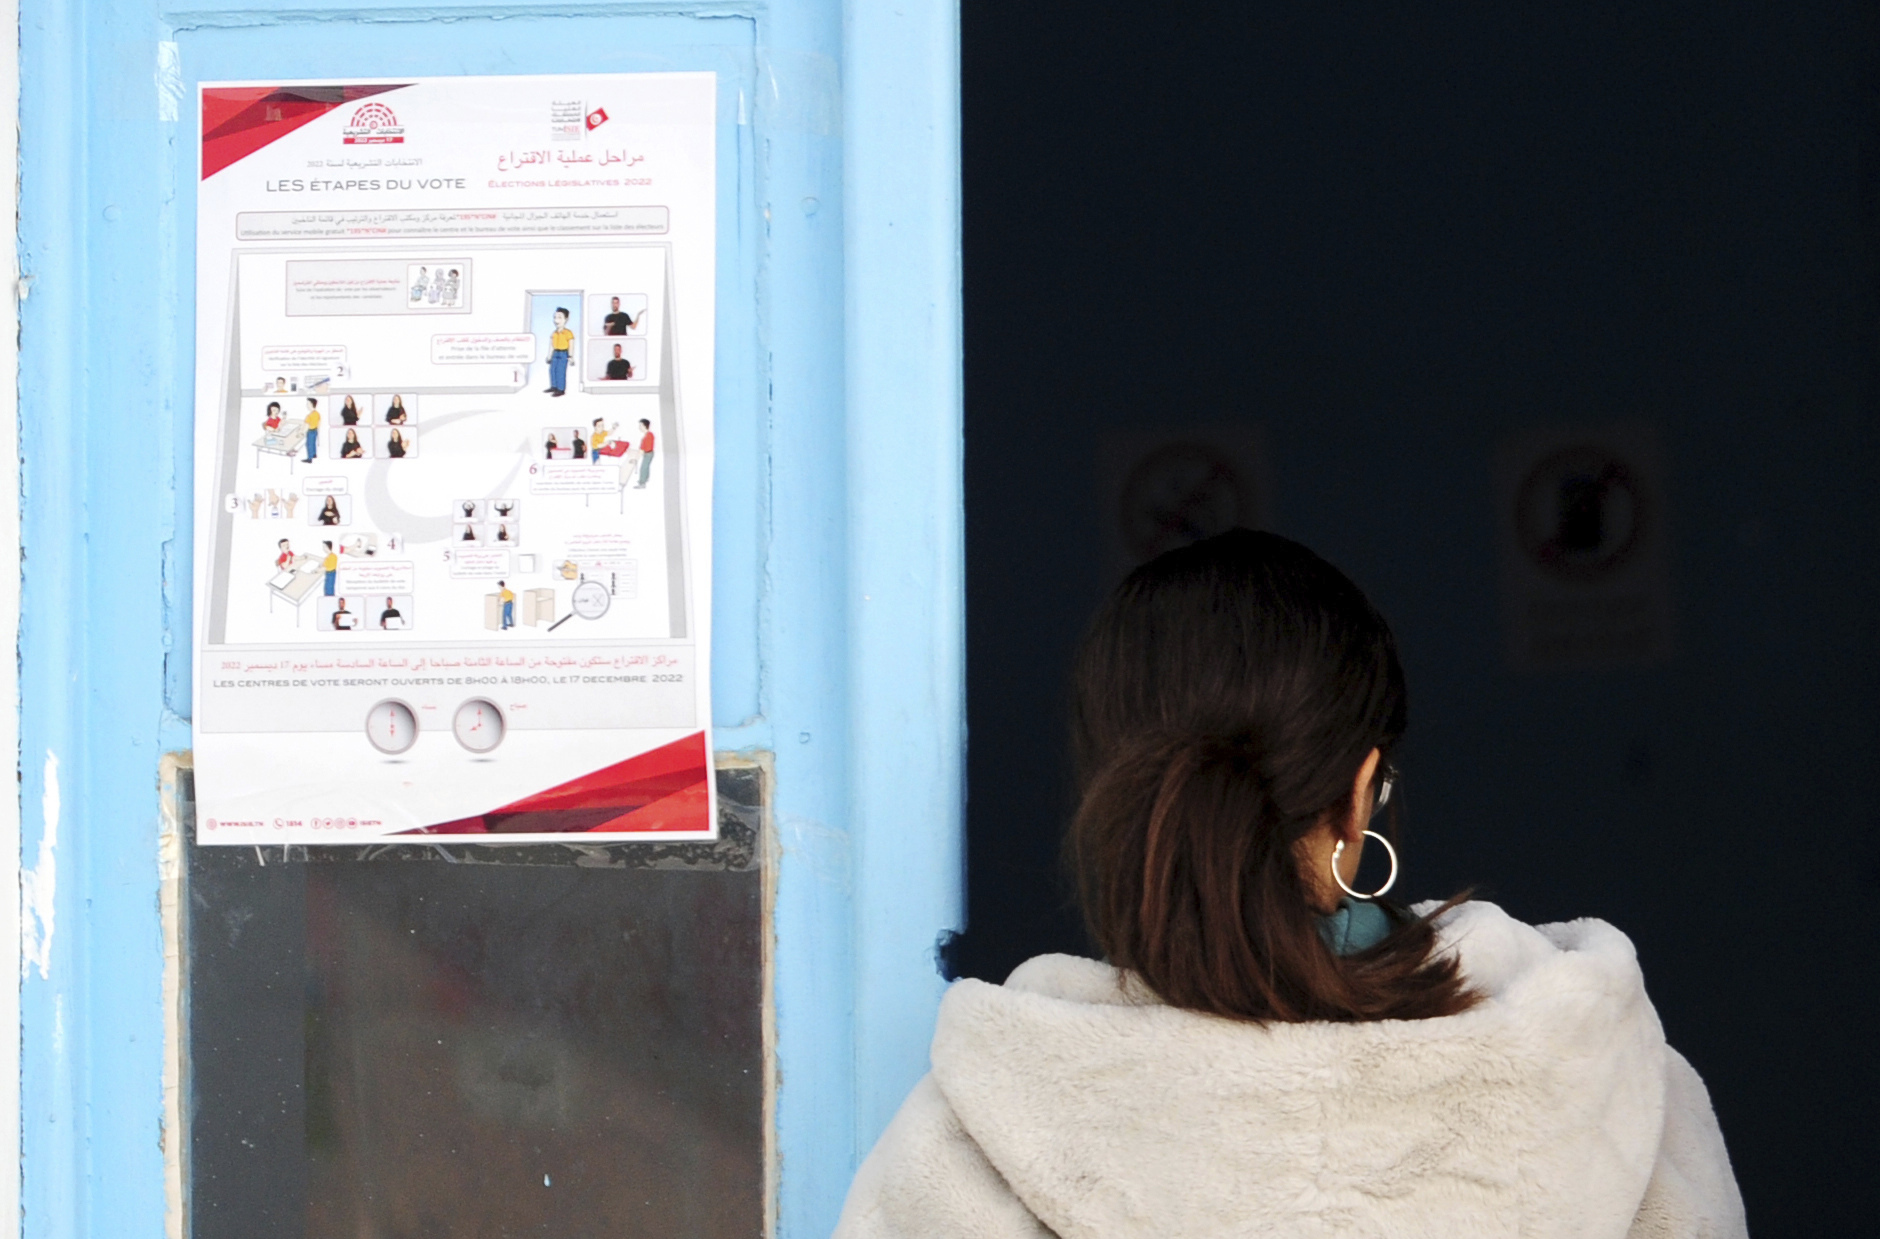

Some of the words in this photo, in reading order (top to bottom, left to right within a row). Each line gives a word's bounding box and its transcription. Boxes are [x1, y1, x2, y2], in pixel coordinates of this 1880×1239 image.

[497, 150, 551, 172] الاقتراع
[556, 150, 593, 169] عملية
[598, 150, 645, 167] مراحل
[266, 179, 305, 192] LES
[310, 177, 381, 191] ÉTAPES
[386, 179, 412, 190] DU
[416, 178, 466, 190] VOTE
[337, 366, 344, 377] 2
[529, 463, 538, 475] 6
[231, 498, 239, 509] 3
[387, 538, 396, 550] 4
[443, 551, 450, 562] 5
[213, 680, 235, 688] LES
[237, 680, 290, 688] CENTRES
[292, 679, 308, 687] DE
[310, 679, 340, 687] VOTE
[342, 678, 388, 686] SERONT
[391, 677, 445, 686] OUVERTS
[446, 677, 462, 685] DE
[552, 676, 567, 684] LE
[568, 675, 580, 683] 17
[652, 674, 684, 683] 2022
